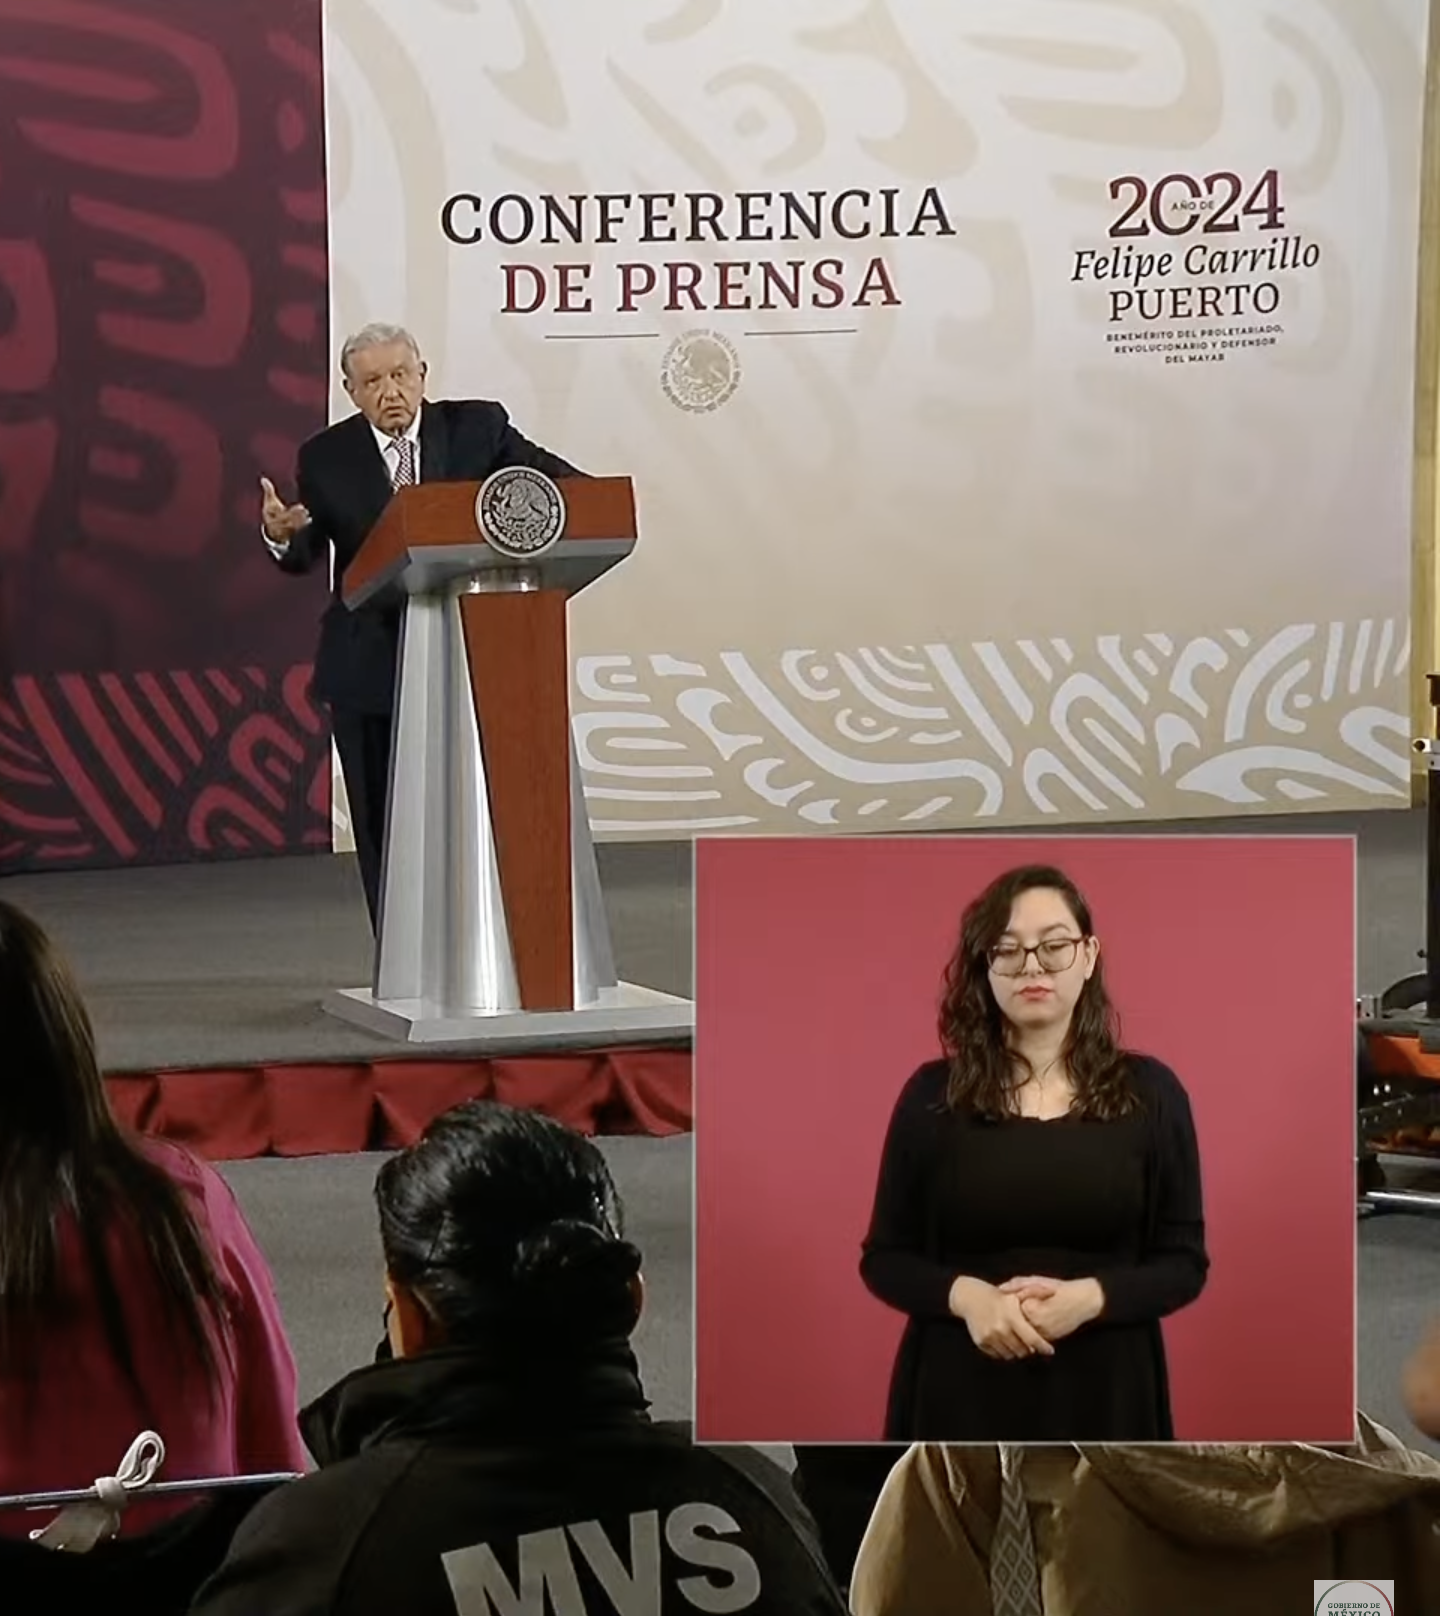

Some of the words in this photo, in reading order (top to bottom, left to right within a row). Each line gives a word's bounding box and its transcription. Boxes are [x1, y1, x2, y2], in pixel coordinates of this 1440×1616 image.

[441, 187, 956, 245] CONFERENCIA
[1108, 169, 1285, 238] 2024
[1171, 200, 1196, 211] AÑO
[1200, 199, 1214, 210] DE
[1071, 245, 1172, 286] Felipe
[1184, 236, 1320, 275] Carrillo
[500, 264, 593, 314] DE
[616, 257, 902, 312] PRENSA
[1109, 282, 1280, 322] PUERTO
[1106, 331, 1174, 342] BENEMÉRITO
[1177, 329, 1197, 338] DEL
[1200, 324, 1285, 337] PROLETARIADO,
[1114, 342, 1208, 354] REVOLUCIONARIO
[1211, 341, 1219, 349] Y
[1221, 337, 1277, 349] DEFENSOR
[1165, 355, 1185, 364] DEL
[1188, 352, 1225, 362] MAYAB
[440, 1502, 761, 1616] MVS
